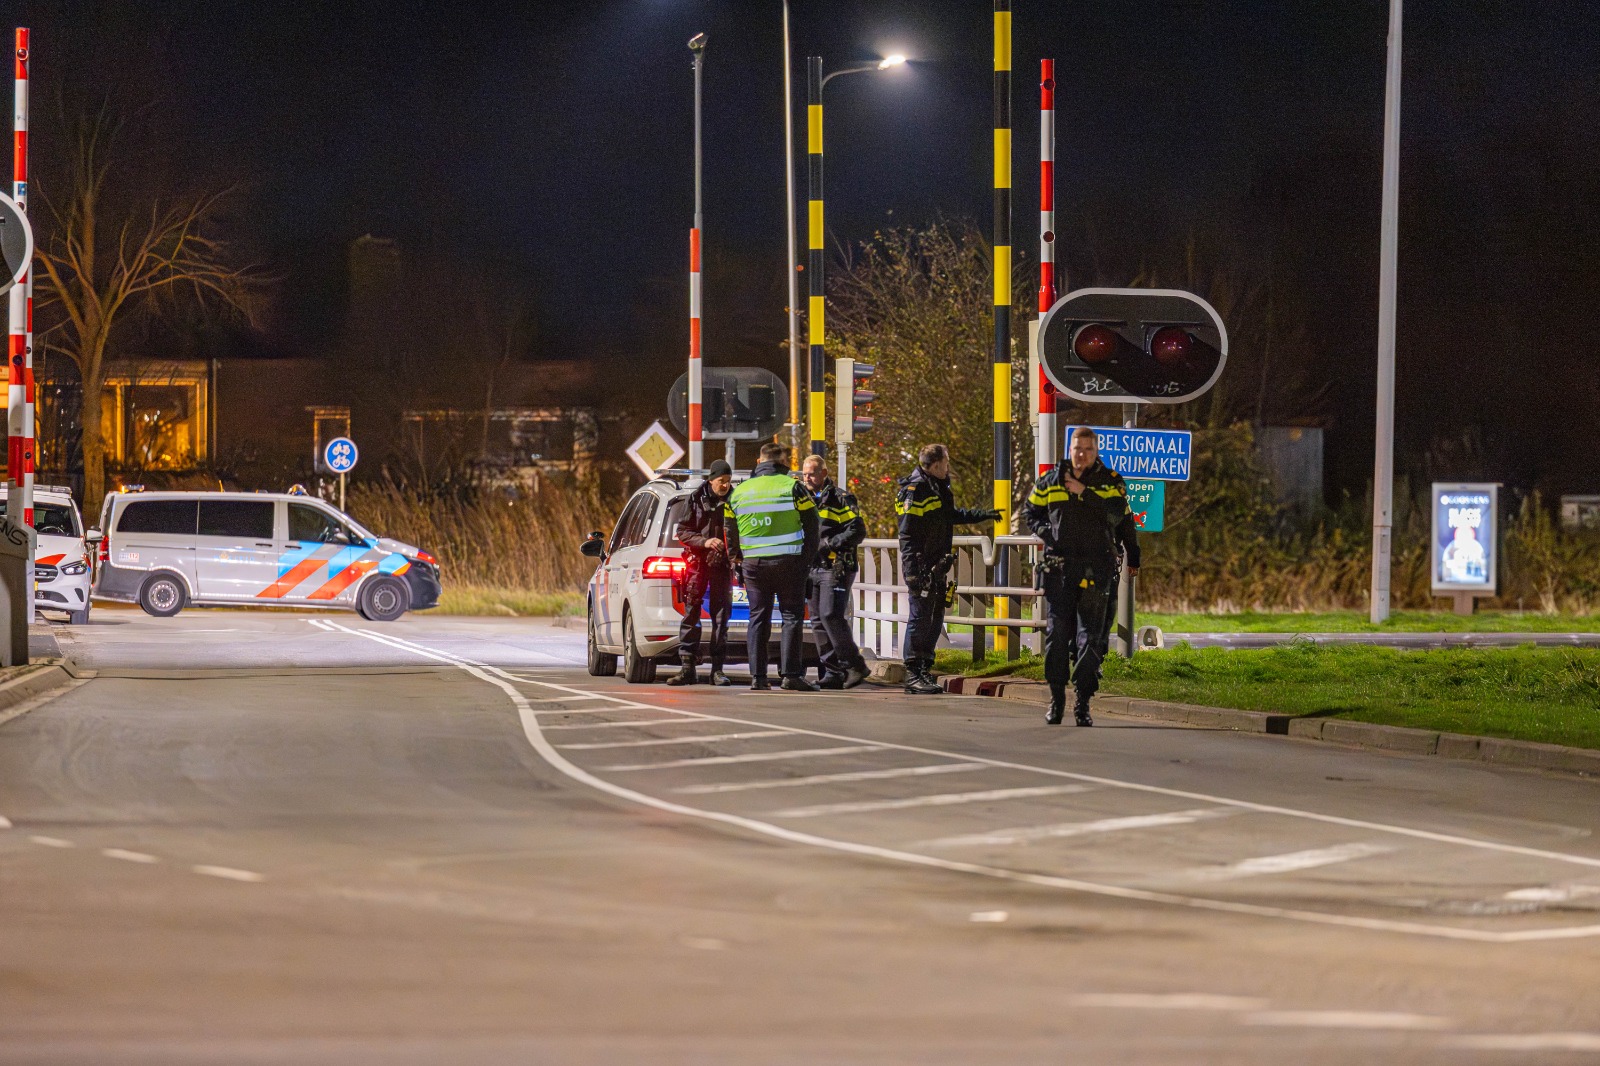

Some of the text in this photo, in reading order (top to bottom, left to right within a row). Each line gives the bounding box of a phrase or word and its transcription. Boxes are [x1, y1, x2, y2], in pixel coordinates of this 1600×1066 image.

[1097, 433, 1186, 455] BELSIGNAAL
[1109, 454, 1188, 475] VRIJMAKEN
[1129, 483, 1154, 492] open
[1139, 493, 1150, 502] af
[750, 516, 772, 527] OvD
